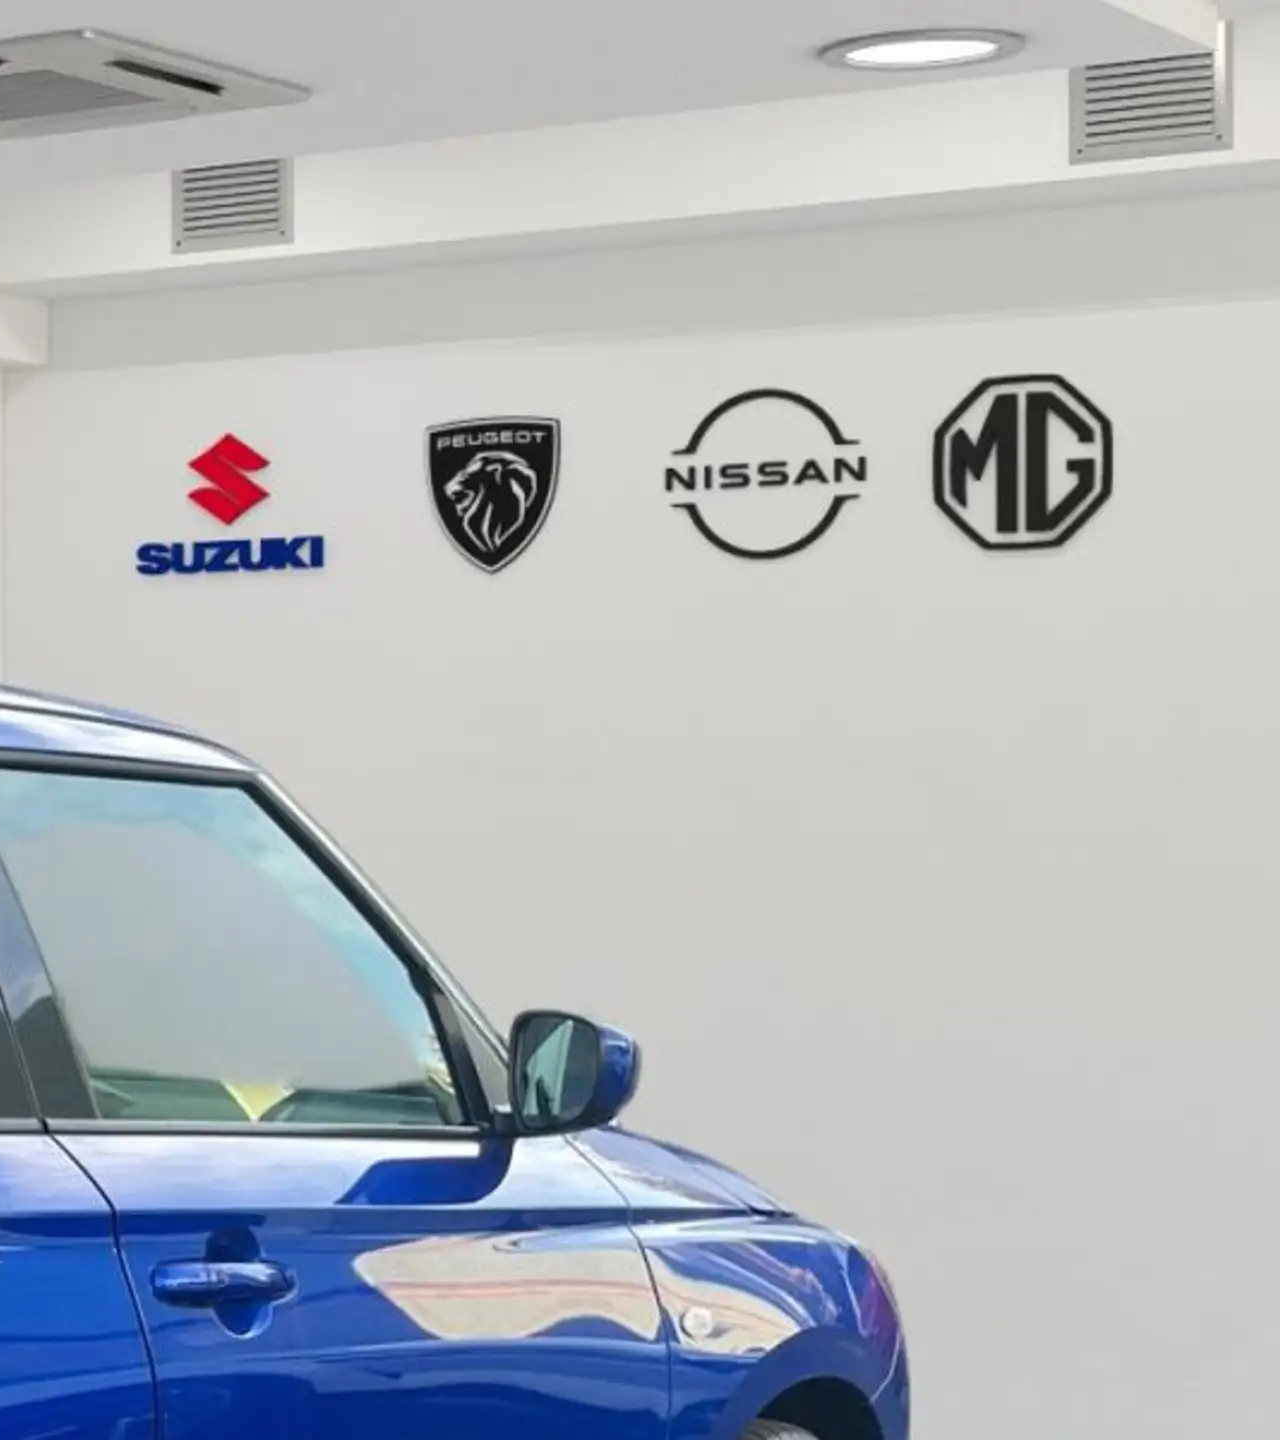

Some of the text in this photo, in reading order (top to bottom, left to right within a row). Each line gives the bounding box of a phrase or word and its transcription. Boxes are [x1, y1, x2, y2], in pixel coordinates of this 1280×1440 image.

[436, 429, 548, 450] PEUGEOT
[664, 455, 868, 492] NISSAN
[949, 391, 1096, 534] MG
[136, 535, 325, 576] SUZUKI
